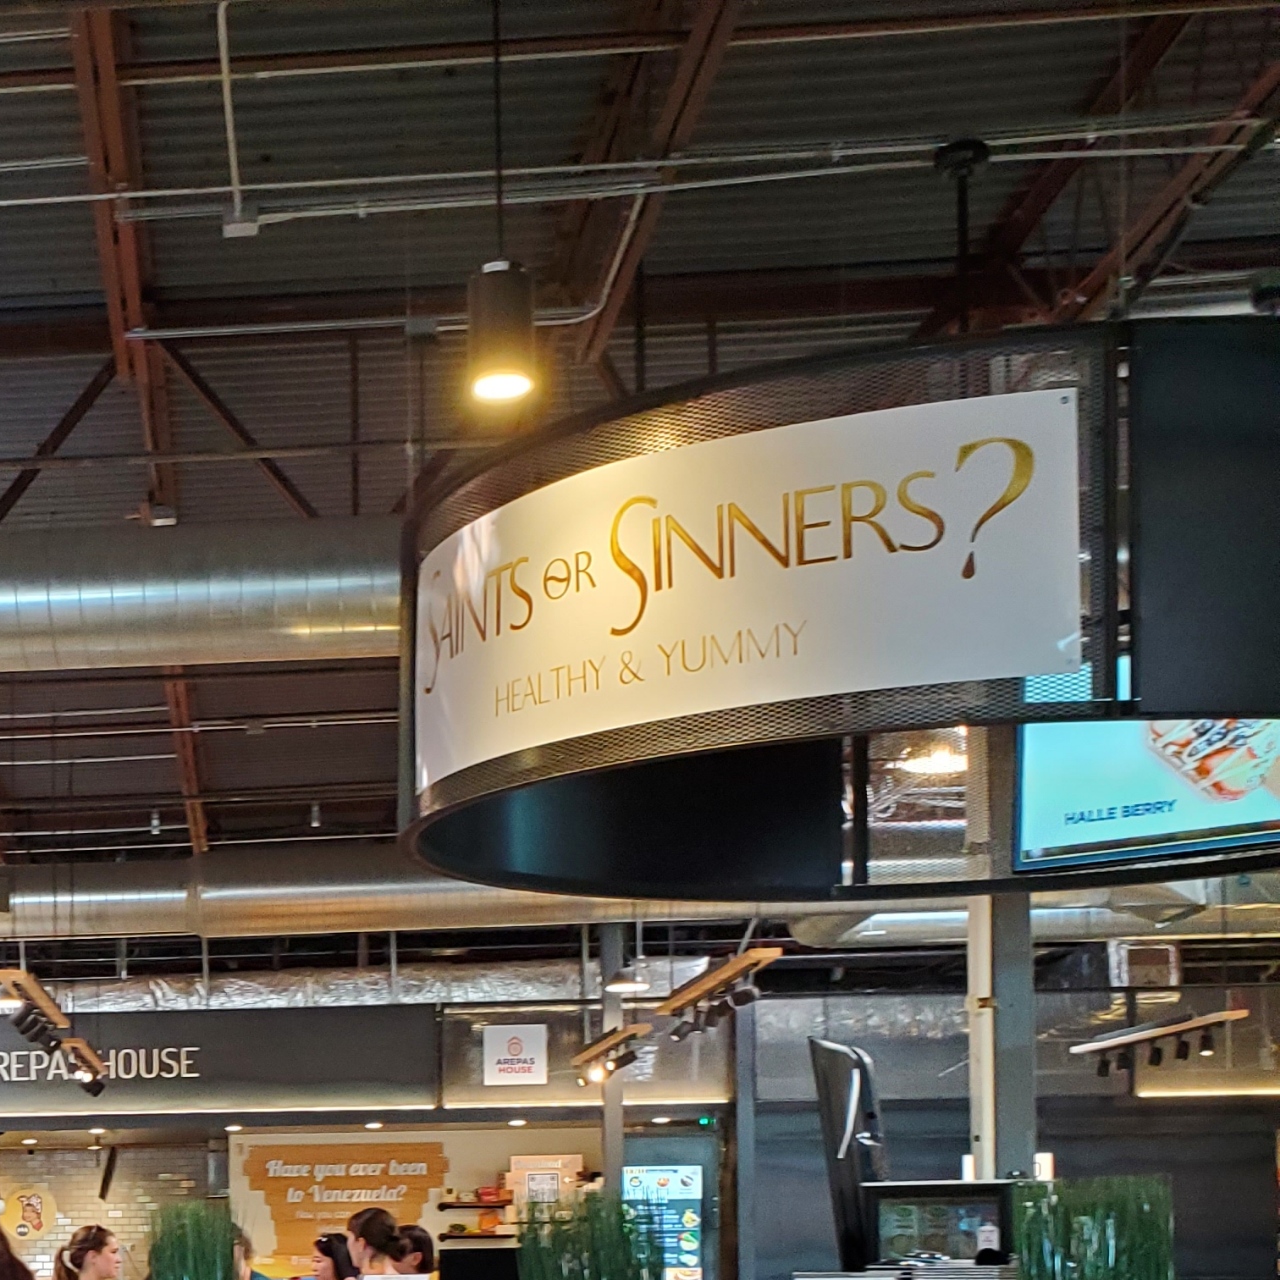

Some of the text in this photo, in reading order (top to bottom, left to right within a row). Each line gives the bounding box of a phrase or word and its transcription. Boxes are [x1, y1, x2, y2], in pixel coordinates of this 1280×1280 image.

[424, 556, 533, 695] SAINTS
[494, 619, 808, 718] HEALTHY & YUMMY
[1064, 798, 1178, 826] HALLE BERRY
[495, 1057, 536, 1066] AREPAS
[498, 1066, 534, 1074] HOUSE
[266, 1159, 428, 1182] Have you ever been
[287, 1184, 408, 1203] to Venezuela?
